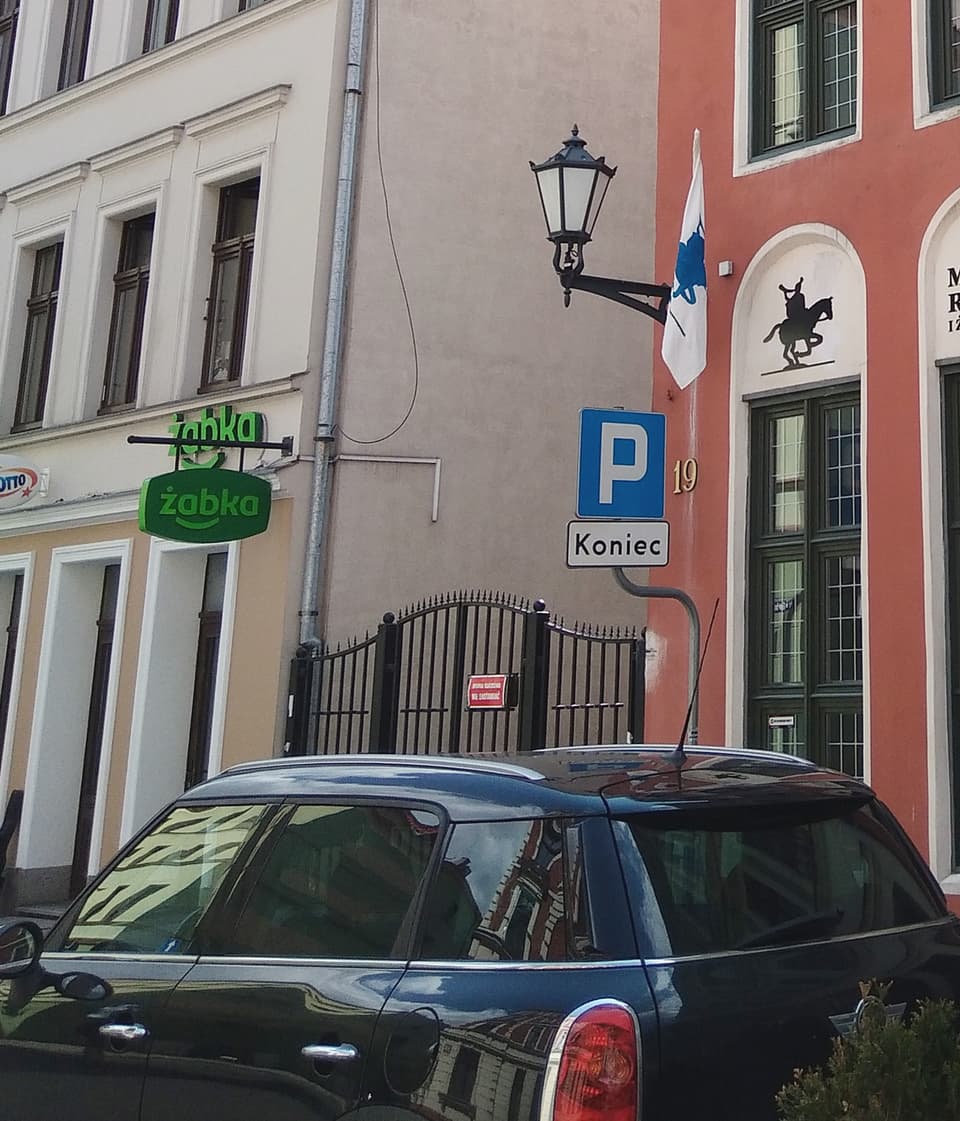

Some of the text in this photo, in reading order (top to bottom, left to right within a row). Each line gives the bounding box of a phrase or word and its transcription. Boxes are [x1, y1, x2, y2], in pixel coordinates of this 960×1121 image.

[948, 320, 953, 333] I
[599, 422, 649, 504] P
[673, 458, 698, 494] 19
[159, 486, 259, 516] żabka
[575, 533, 661, 556] Koniec
